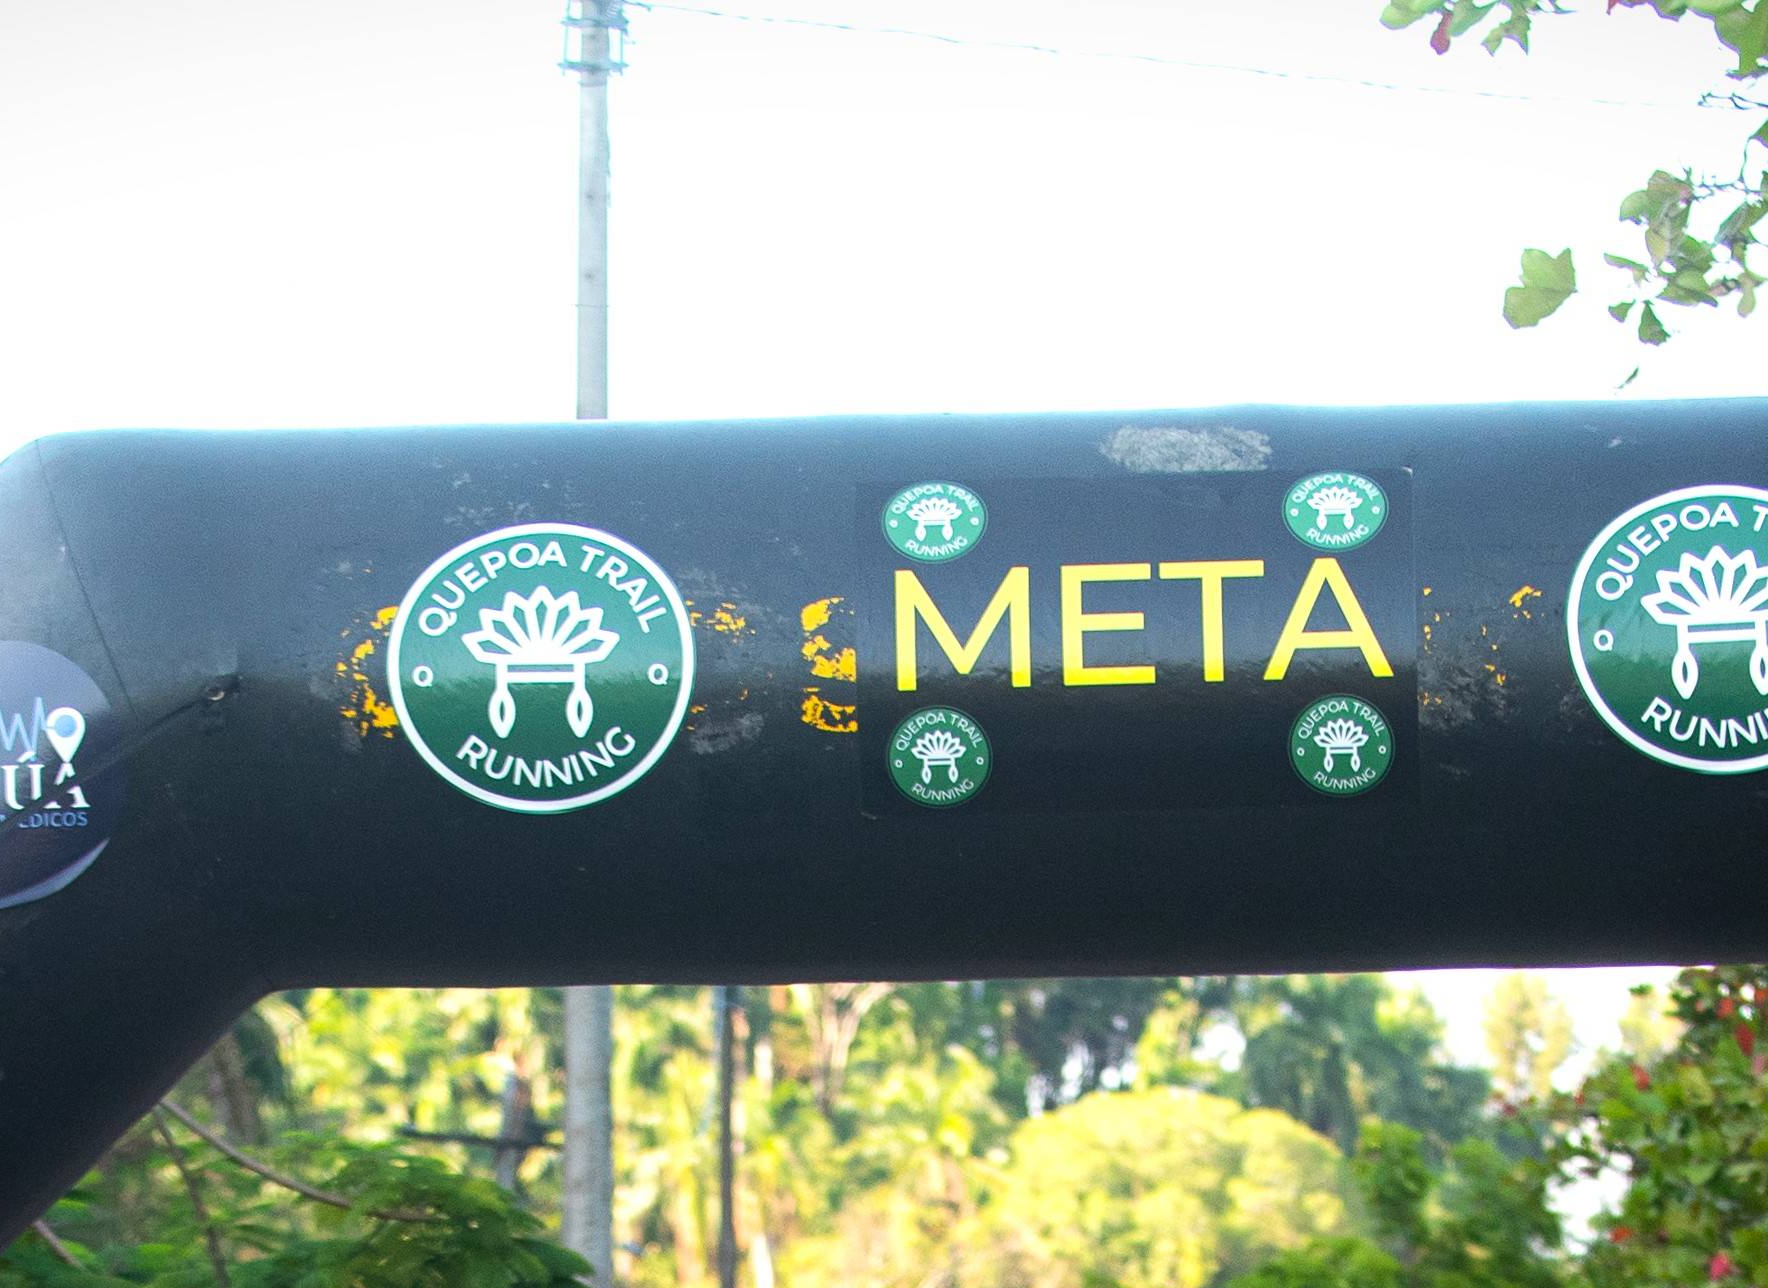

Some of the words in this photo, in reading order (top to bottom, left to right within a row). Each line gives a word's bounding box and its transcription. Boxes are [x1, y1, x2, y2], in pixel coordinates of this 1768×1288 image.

[904, 536, 968, 558] RUNNING
[1305, 524, 1369, 546] RUNNING
[1595, 501, 1739, 602] QUEPOA
[418, 541, 567, 637] QUEPOA
[580, 544, 668, 634] TRAIL
[894, 556, 1394, 692] META
[895, 711, 947, 751] QUEPOA
[951, 713, 983, 749] TRAIL
[1298, 700, 1349, 740] QUEPOA
[1352, 701, 1386, 737] TRAIL
[455, 726, 637, 788] RUNNING
[911, 777, 975, 801] RUNNING
[1313, 767, 1377, 790] RUNNING
